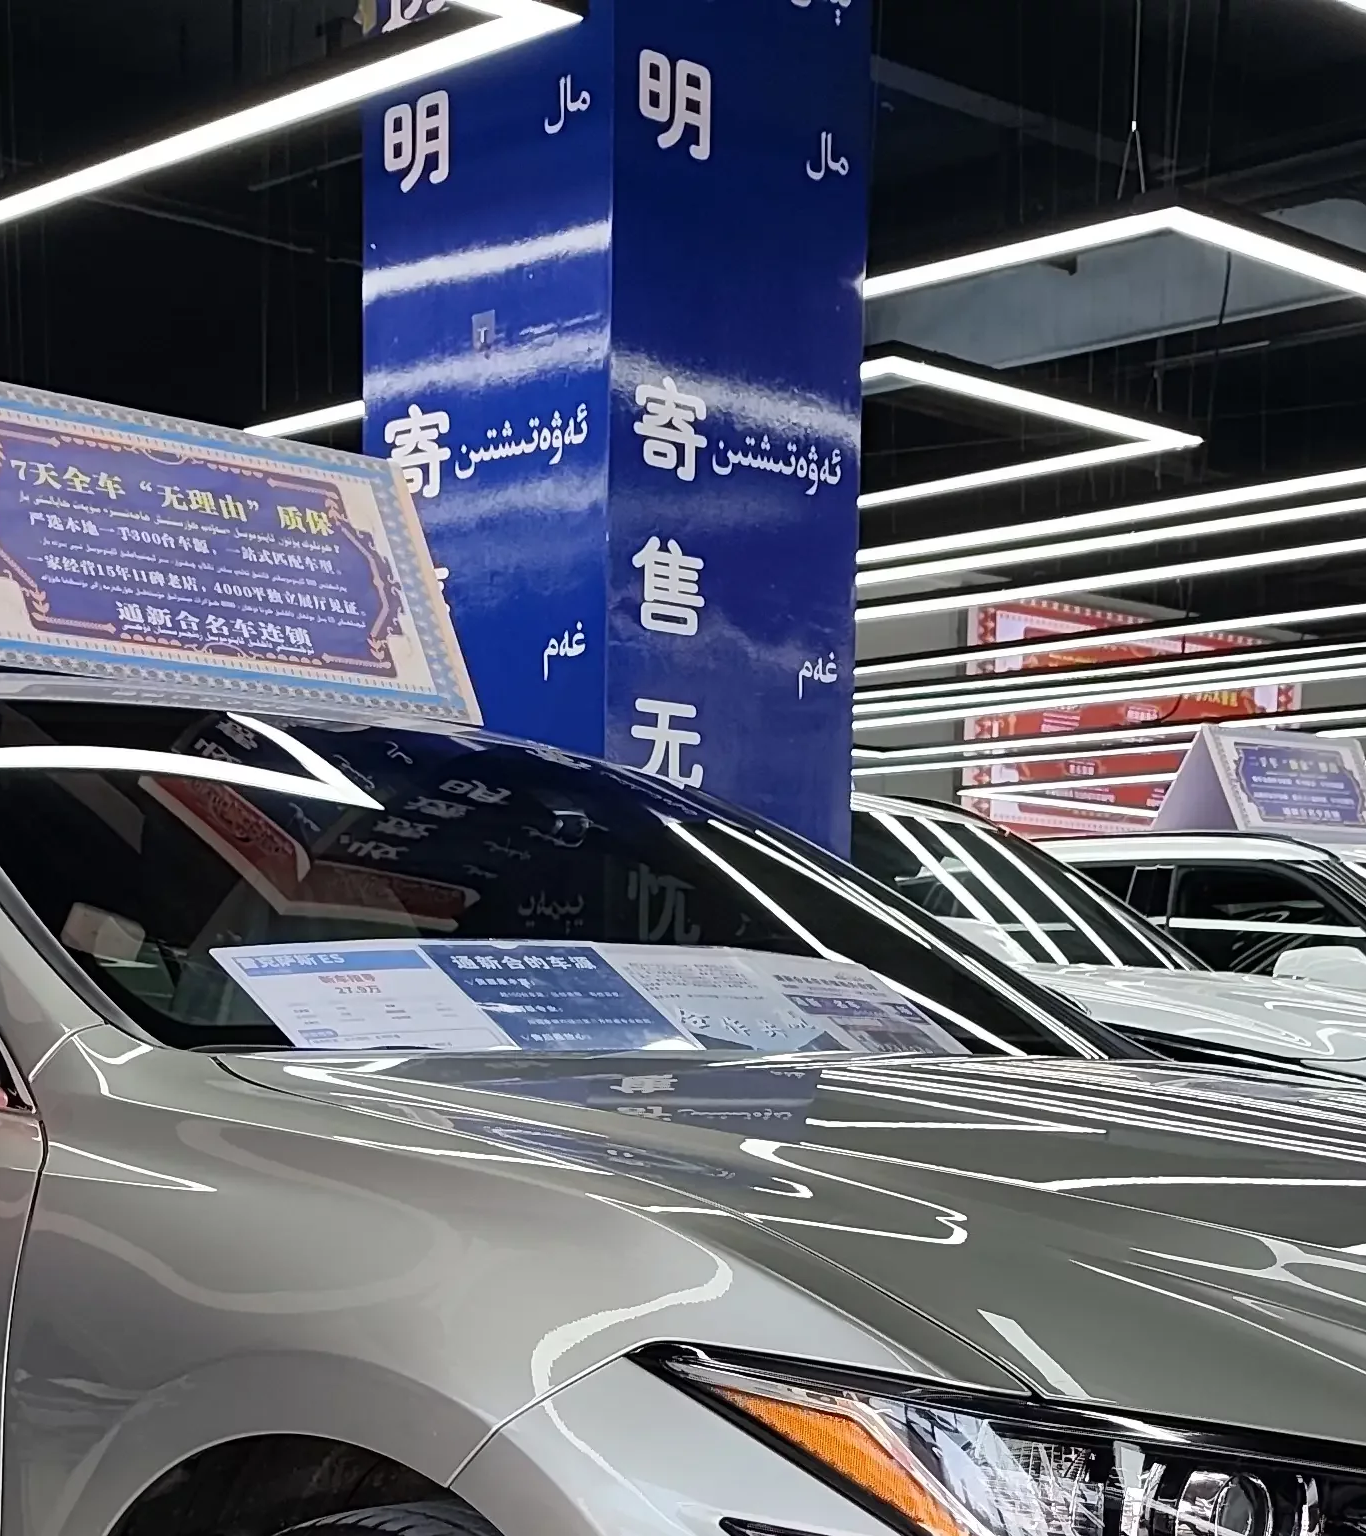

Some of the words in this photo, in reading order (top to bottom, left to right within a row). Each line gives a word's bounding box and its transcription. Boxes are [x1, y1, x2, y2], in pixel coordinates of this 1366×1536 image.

[544, 75, 591, 135] مال
[638, 48, 712, 161] 明
[806, 131, 850, 181] مال
[318, 953, 345, 964] ES
